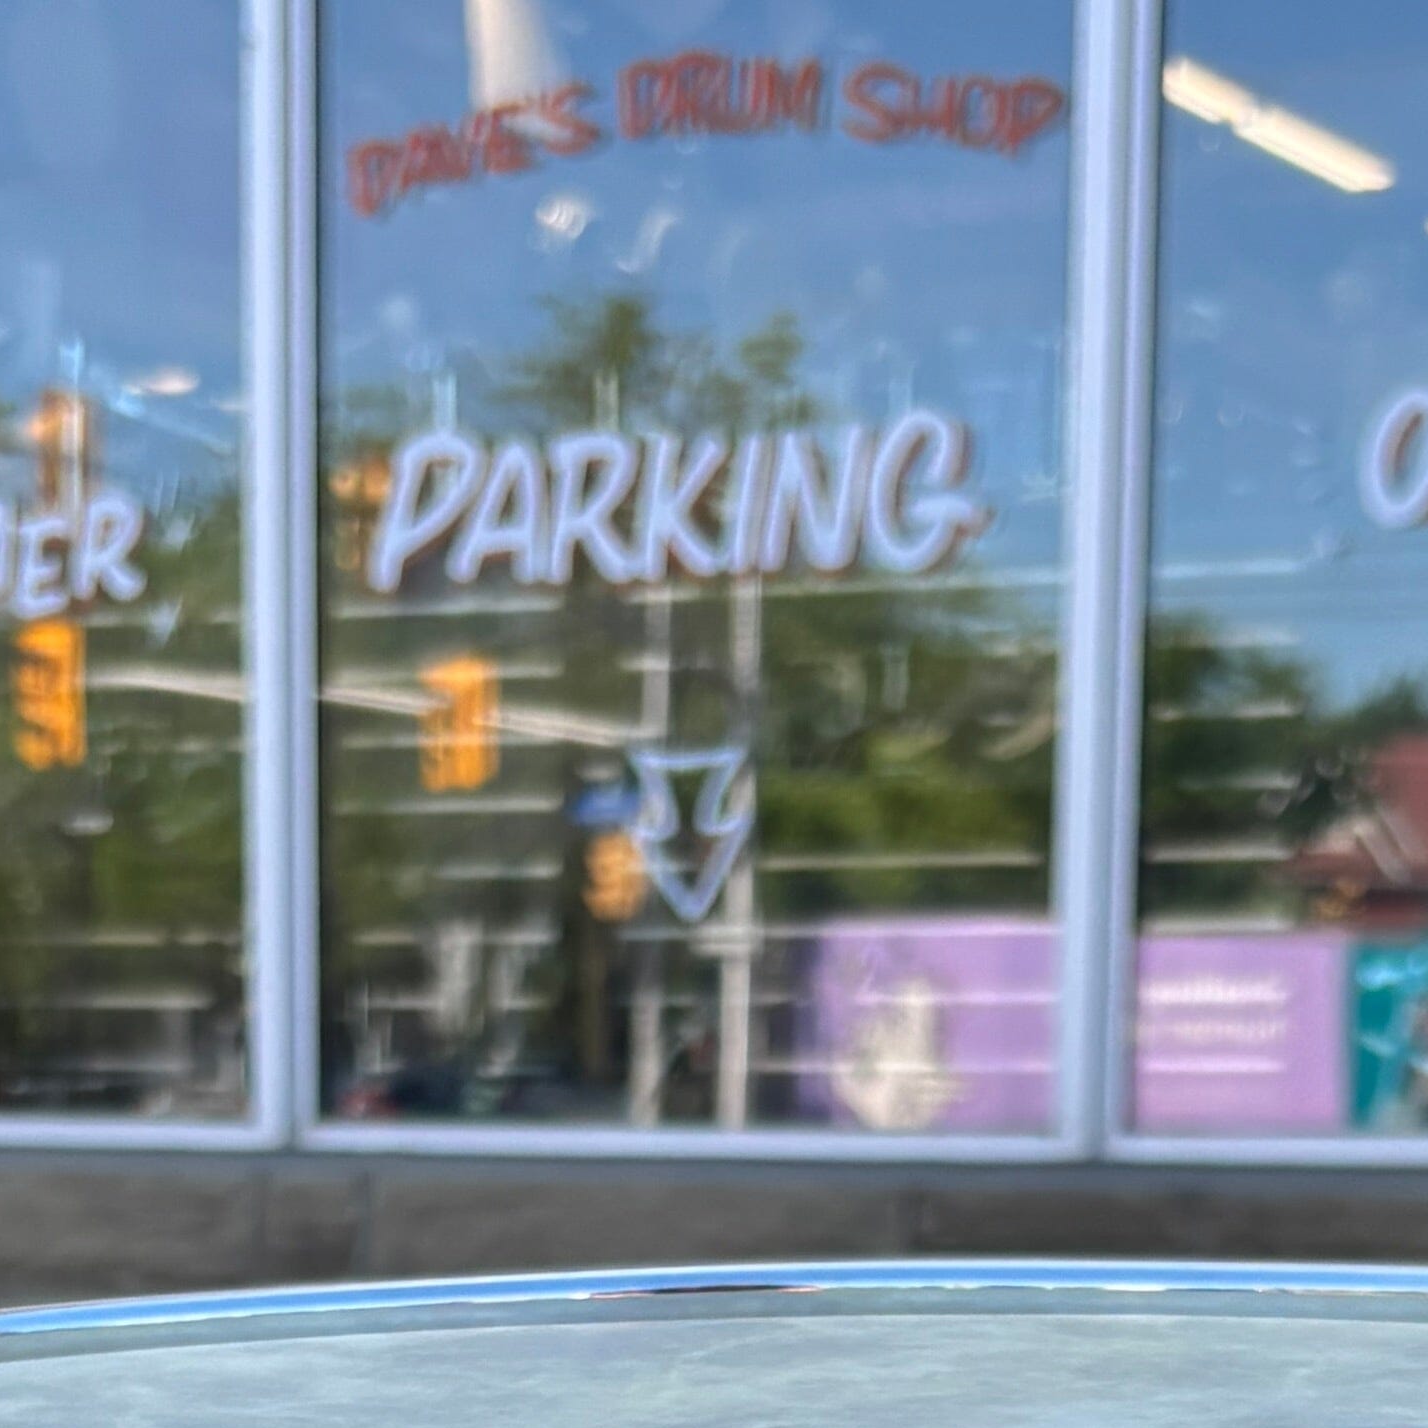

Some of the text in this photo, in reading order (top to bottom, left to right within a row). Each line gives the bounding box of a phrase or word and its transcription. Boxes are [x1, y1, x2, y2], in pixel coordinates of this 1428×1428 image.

[618, 48, 824, 138] DRUM
[840, 62, 1066, 156] SHOP
[370, 410, 992, 592] PARKING
